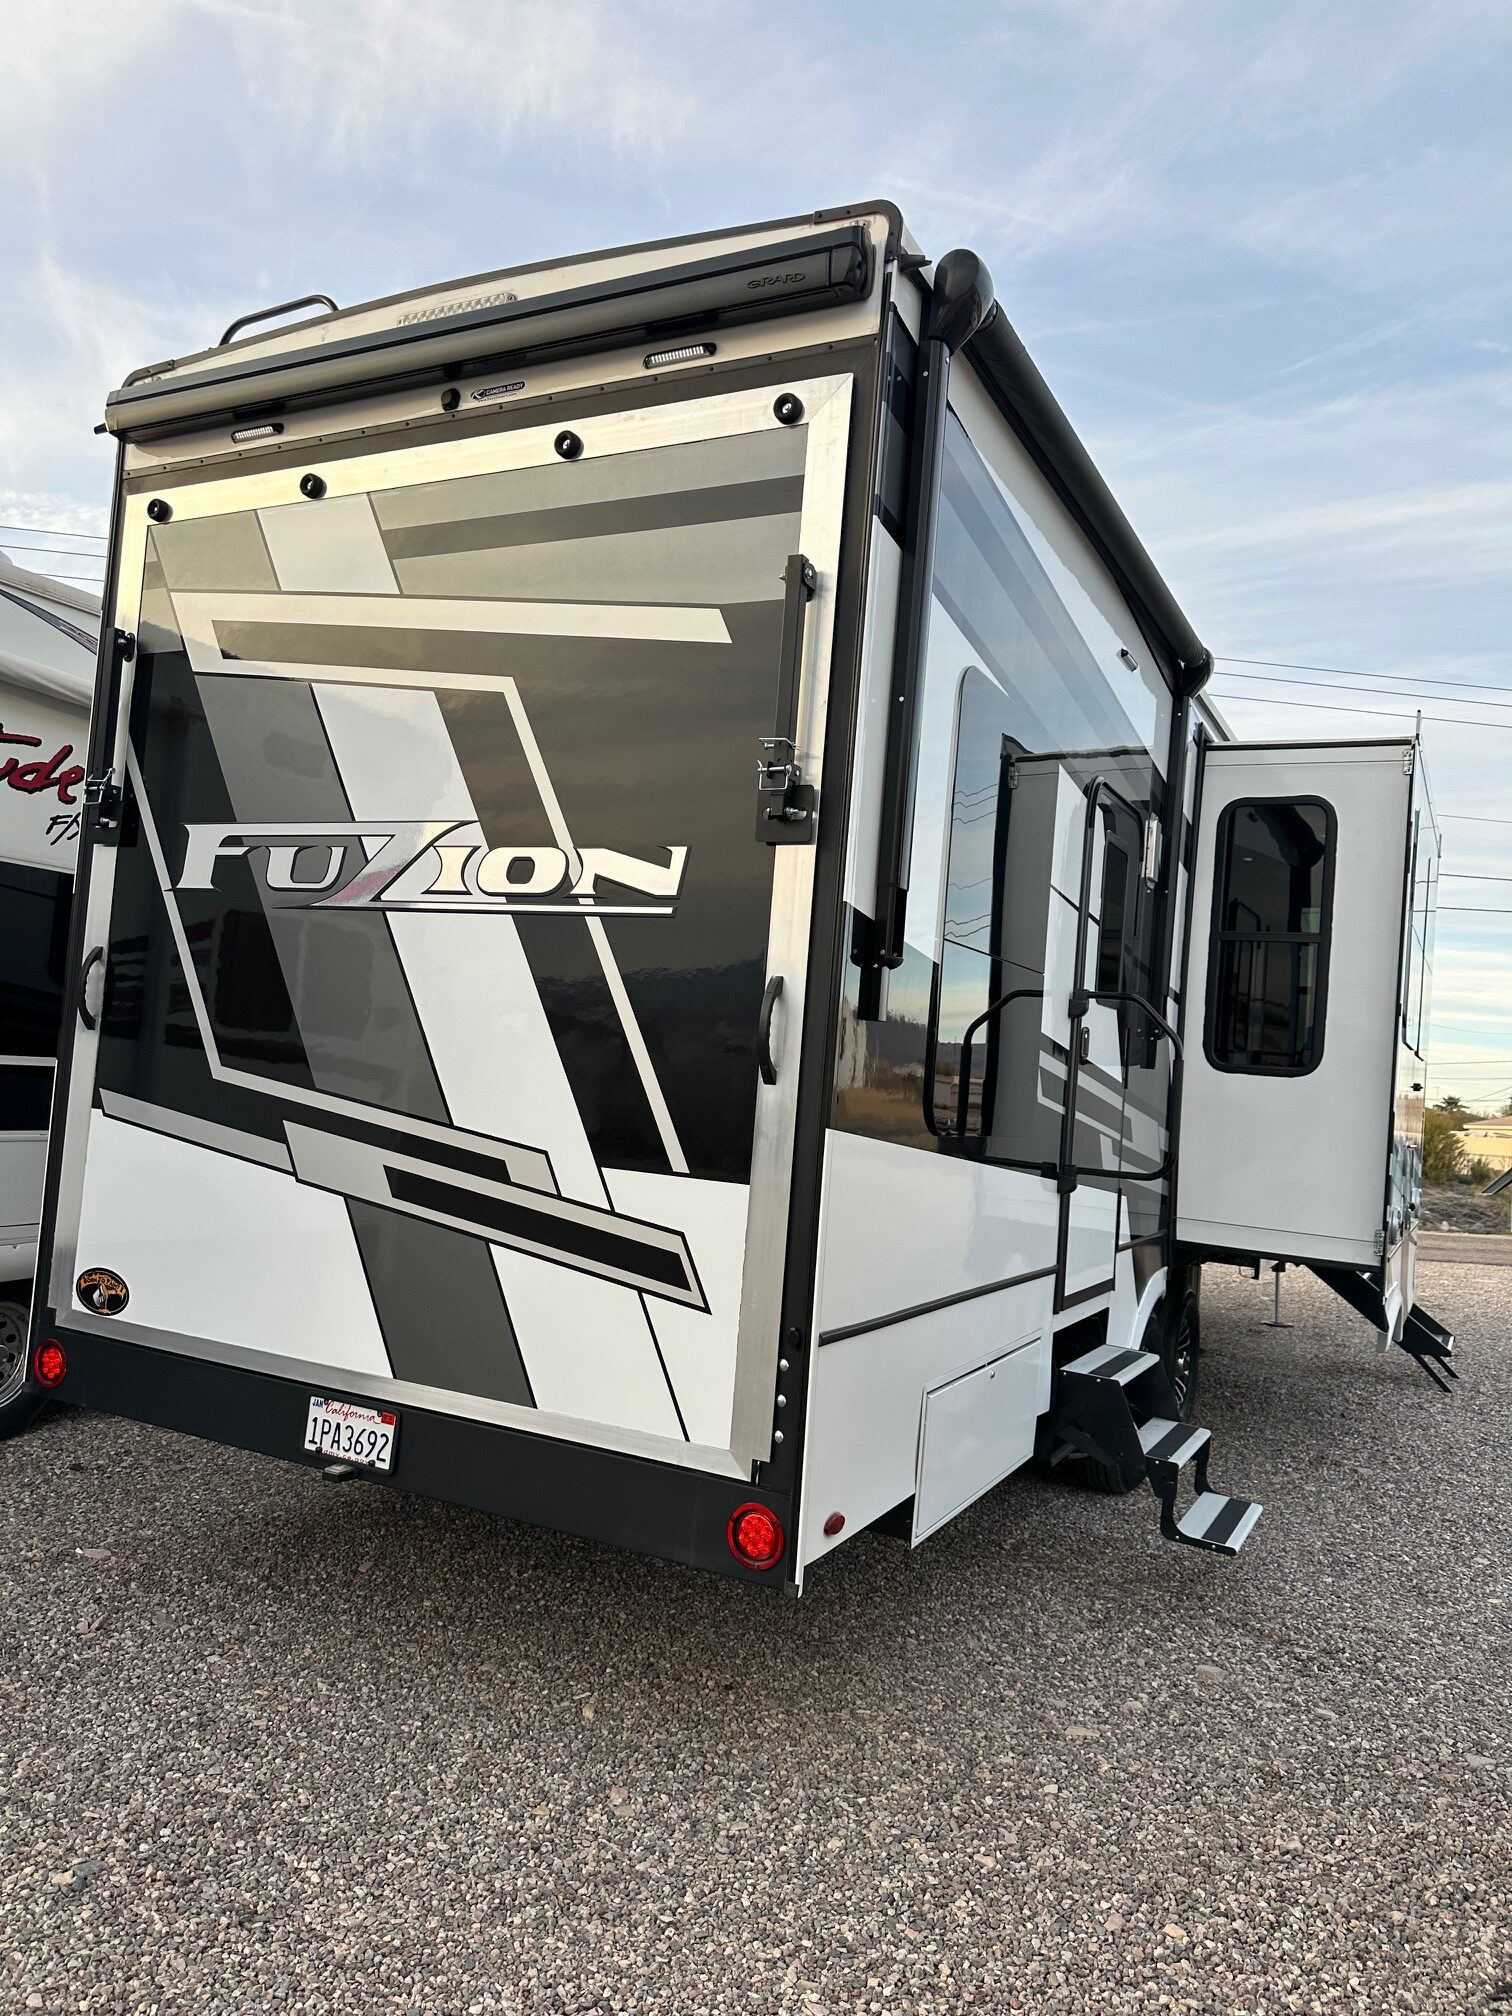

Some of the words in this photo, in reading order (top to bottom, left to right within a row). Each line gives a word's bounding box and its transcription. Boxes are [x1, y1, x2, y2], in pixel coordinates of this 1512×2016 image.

[486, 386, 507, 395] CAMERA
[507, 382, 524, 391] READY
[166, 820, 693, 918] FUZION
[312, 1398, 324, 1408] JAN
[325, 1399, 382, 1424] California
[308, 1416, 390, 1463] 1PA3692
